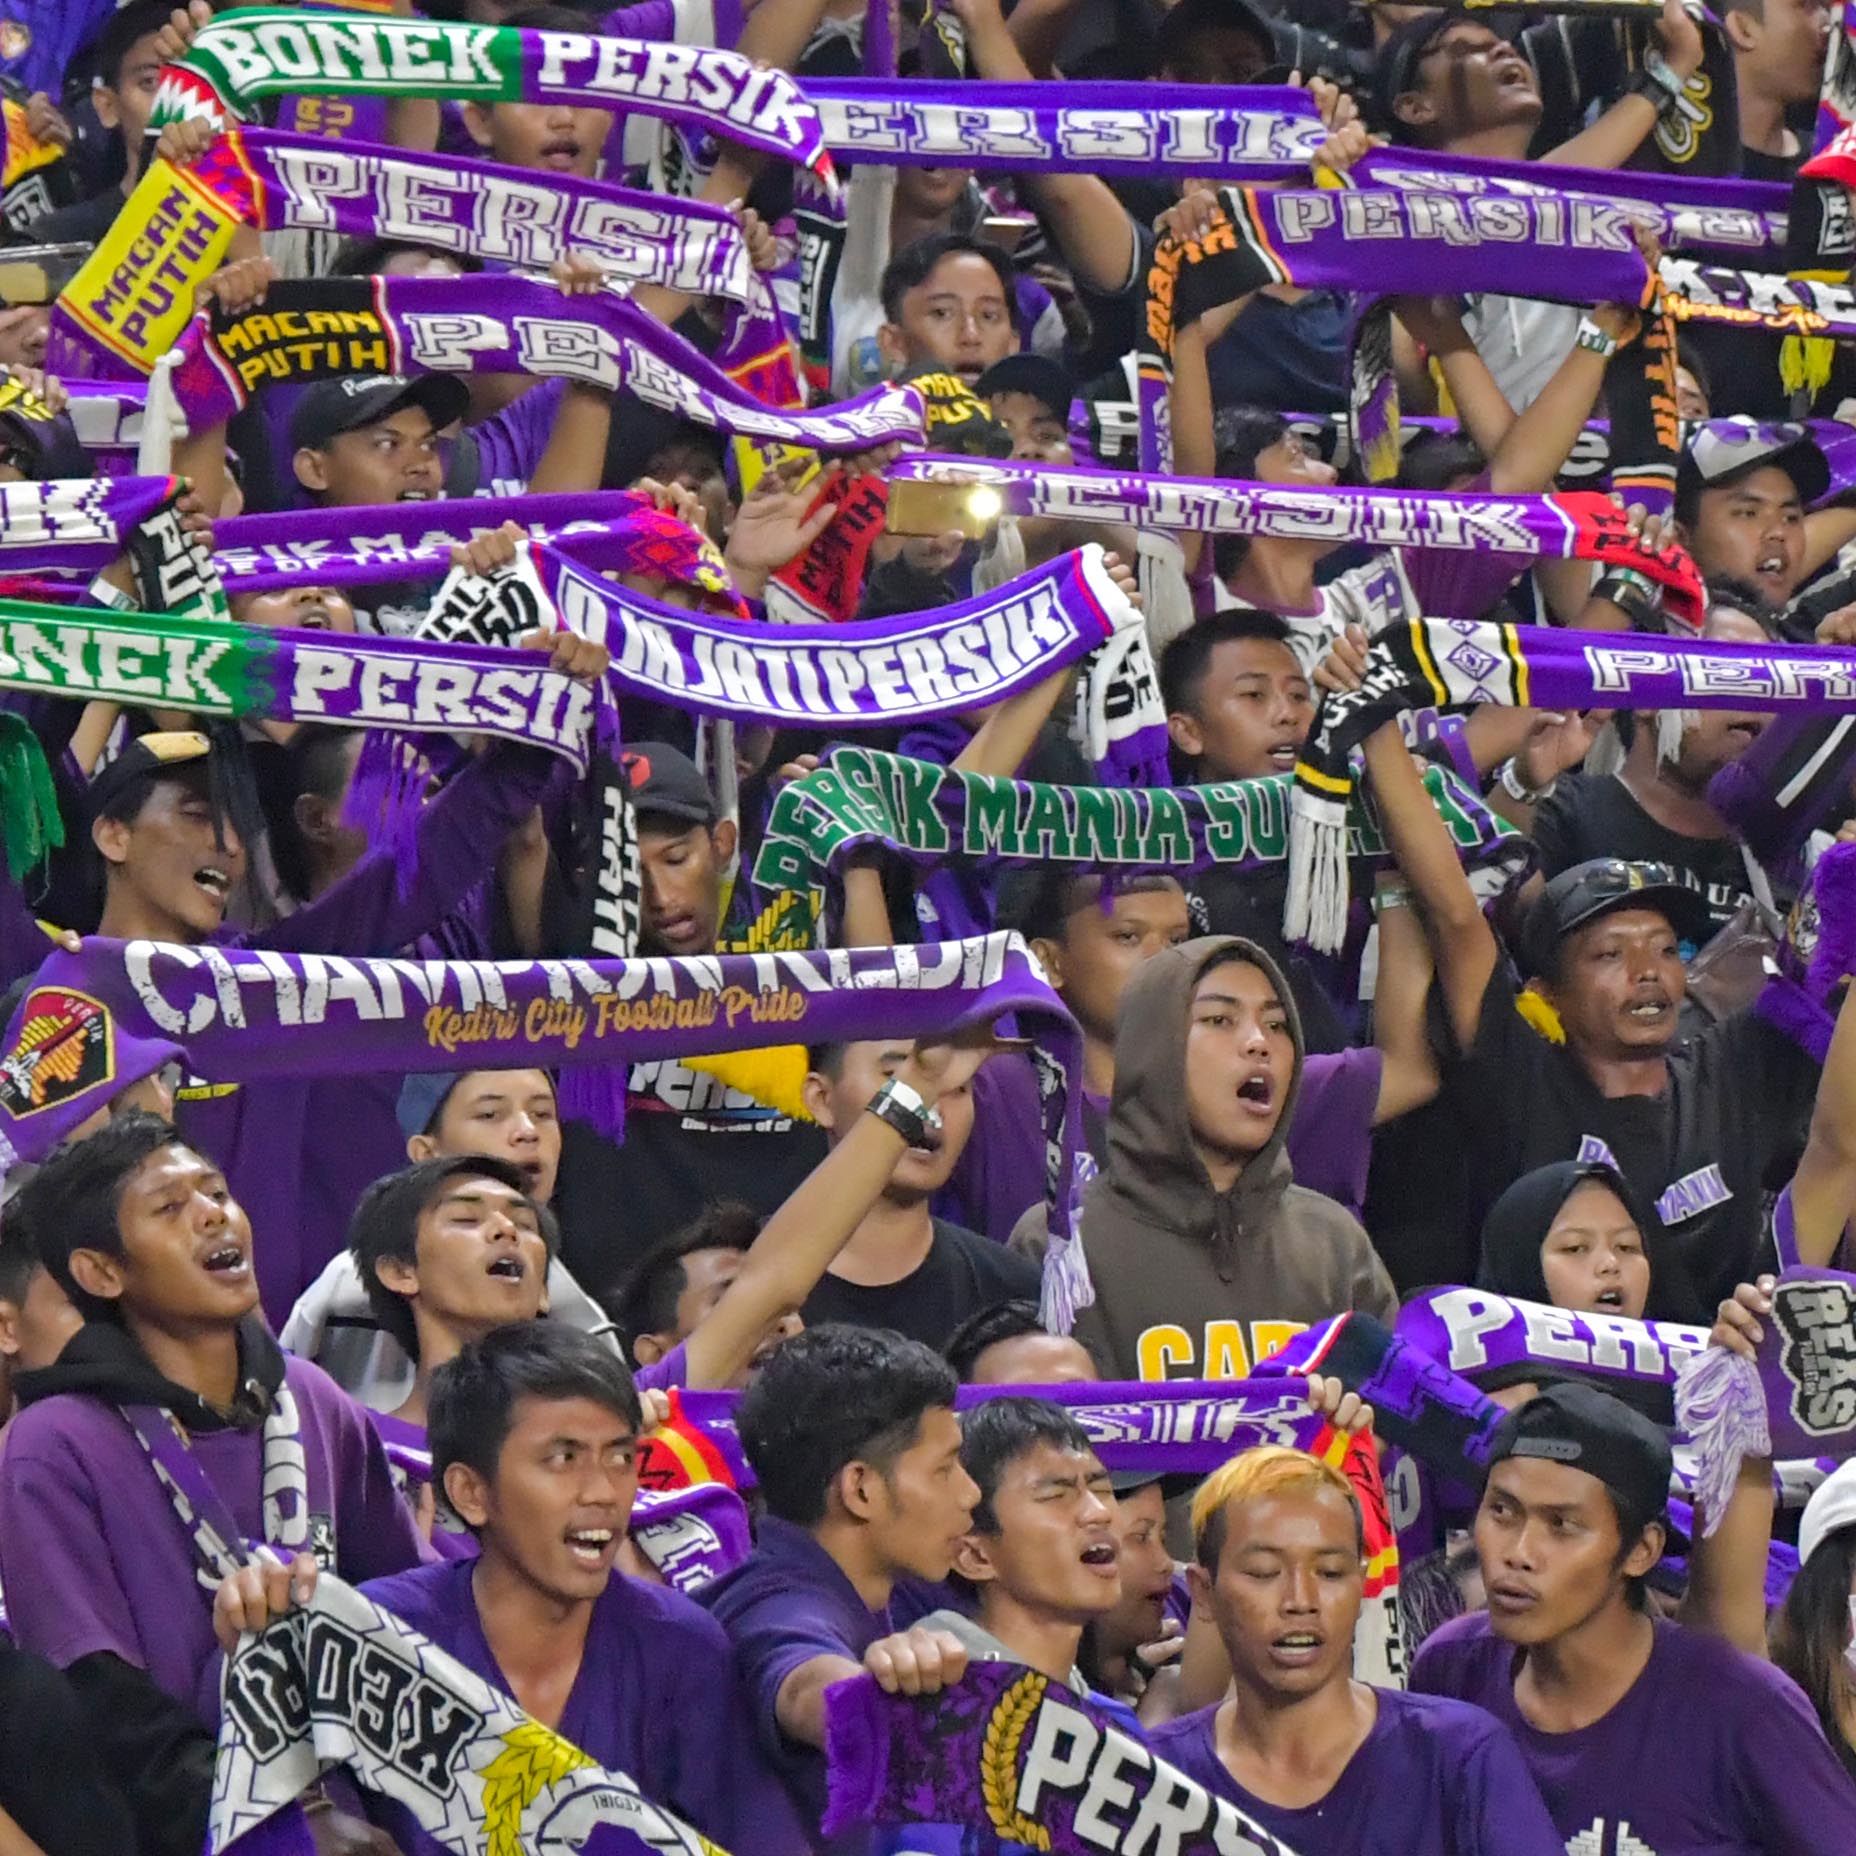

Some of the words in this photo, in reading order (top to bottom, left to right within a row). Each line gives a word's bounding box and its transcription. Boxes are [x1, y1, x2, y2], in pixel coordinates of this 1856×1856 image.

[196, 23, 504, 97] BONEK
[538, 31, 823, 149] PERSIK
[824, 101, 1331, 166] ERSIK
[89, 186, 193, 324] MACAN
[118, 212, 219, 344] PUTIH
[1274, 195, 1634, 247] PERSIK
[221, 308, 380, 352] MACAN
[245, 345, 388, 390] PUTIH
[402, 318, 921, 448] PERSIK
[1024, 472, 1544, 542] ERSIK
[293, 646, 600, 770] PERSIK
[832, 585, 1073, 712] PERSIK
[754, 749, 947, 884] PERSIK
[966, 772, 1192, 866] MANIA
[425, 999, 519, 1049] Kediri
[528, 999, 586, 1044] City
[593, 990, 717, 1029] Football
[721, 988, 807, 1026] Pride
